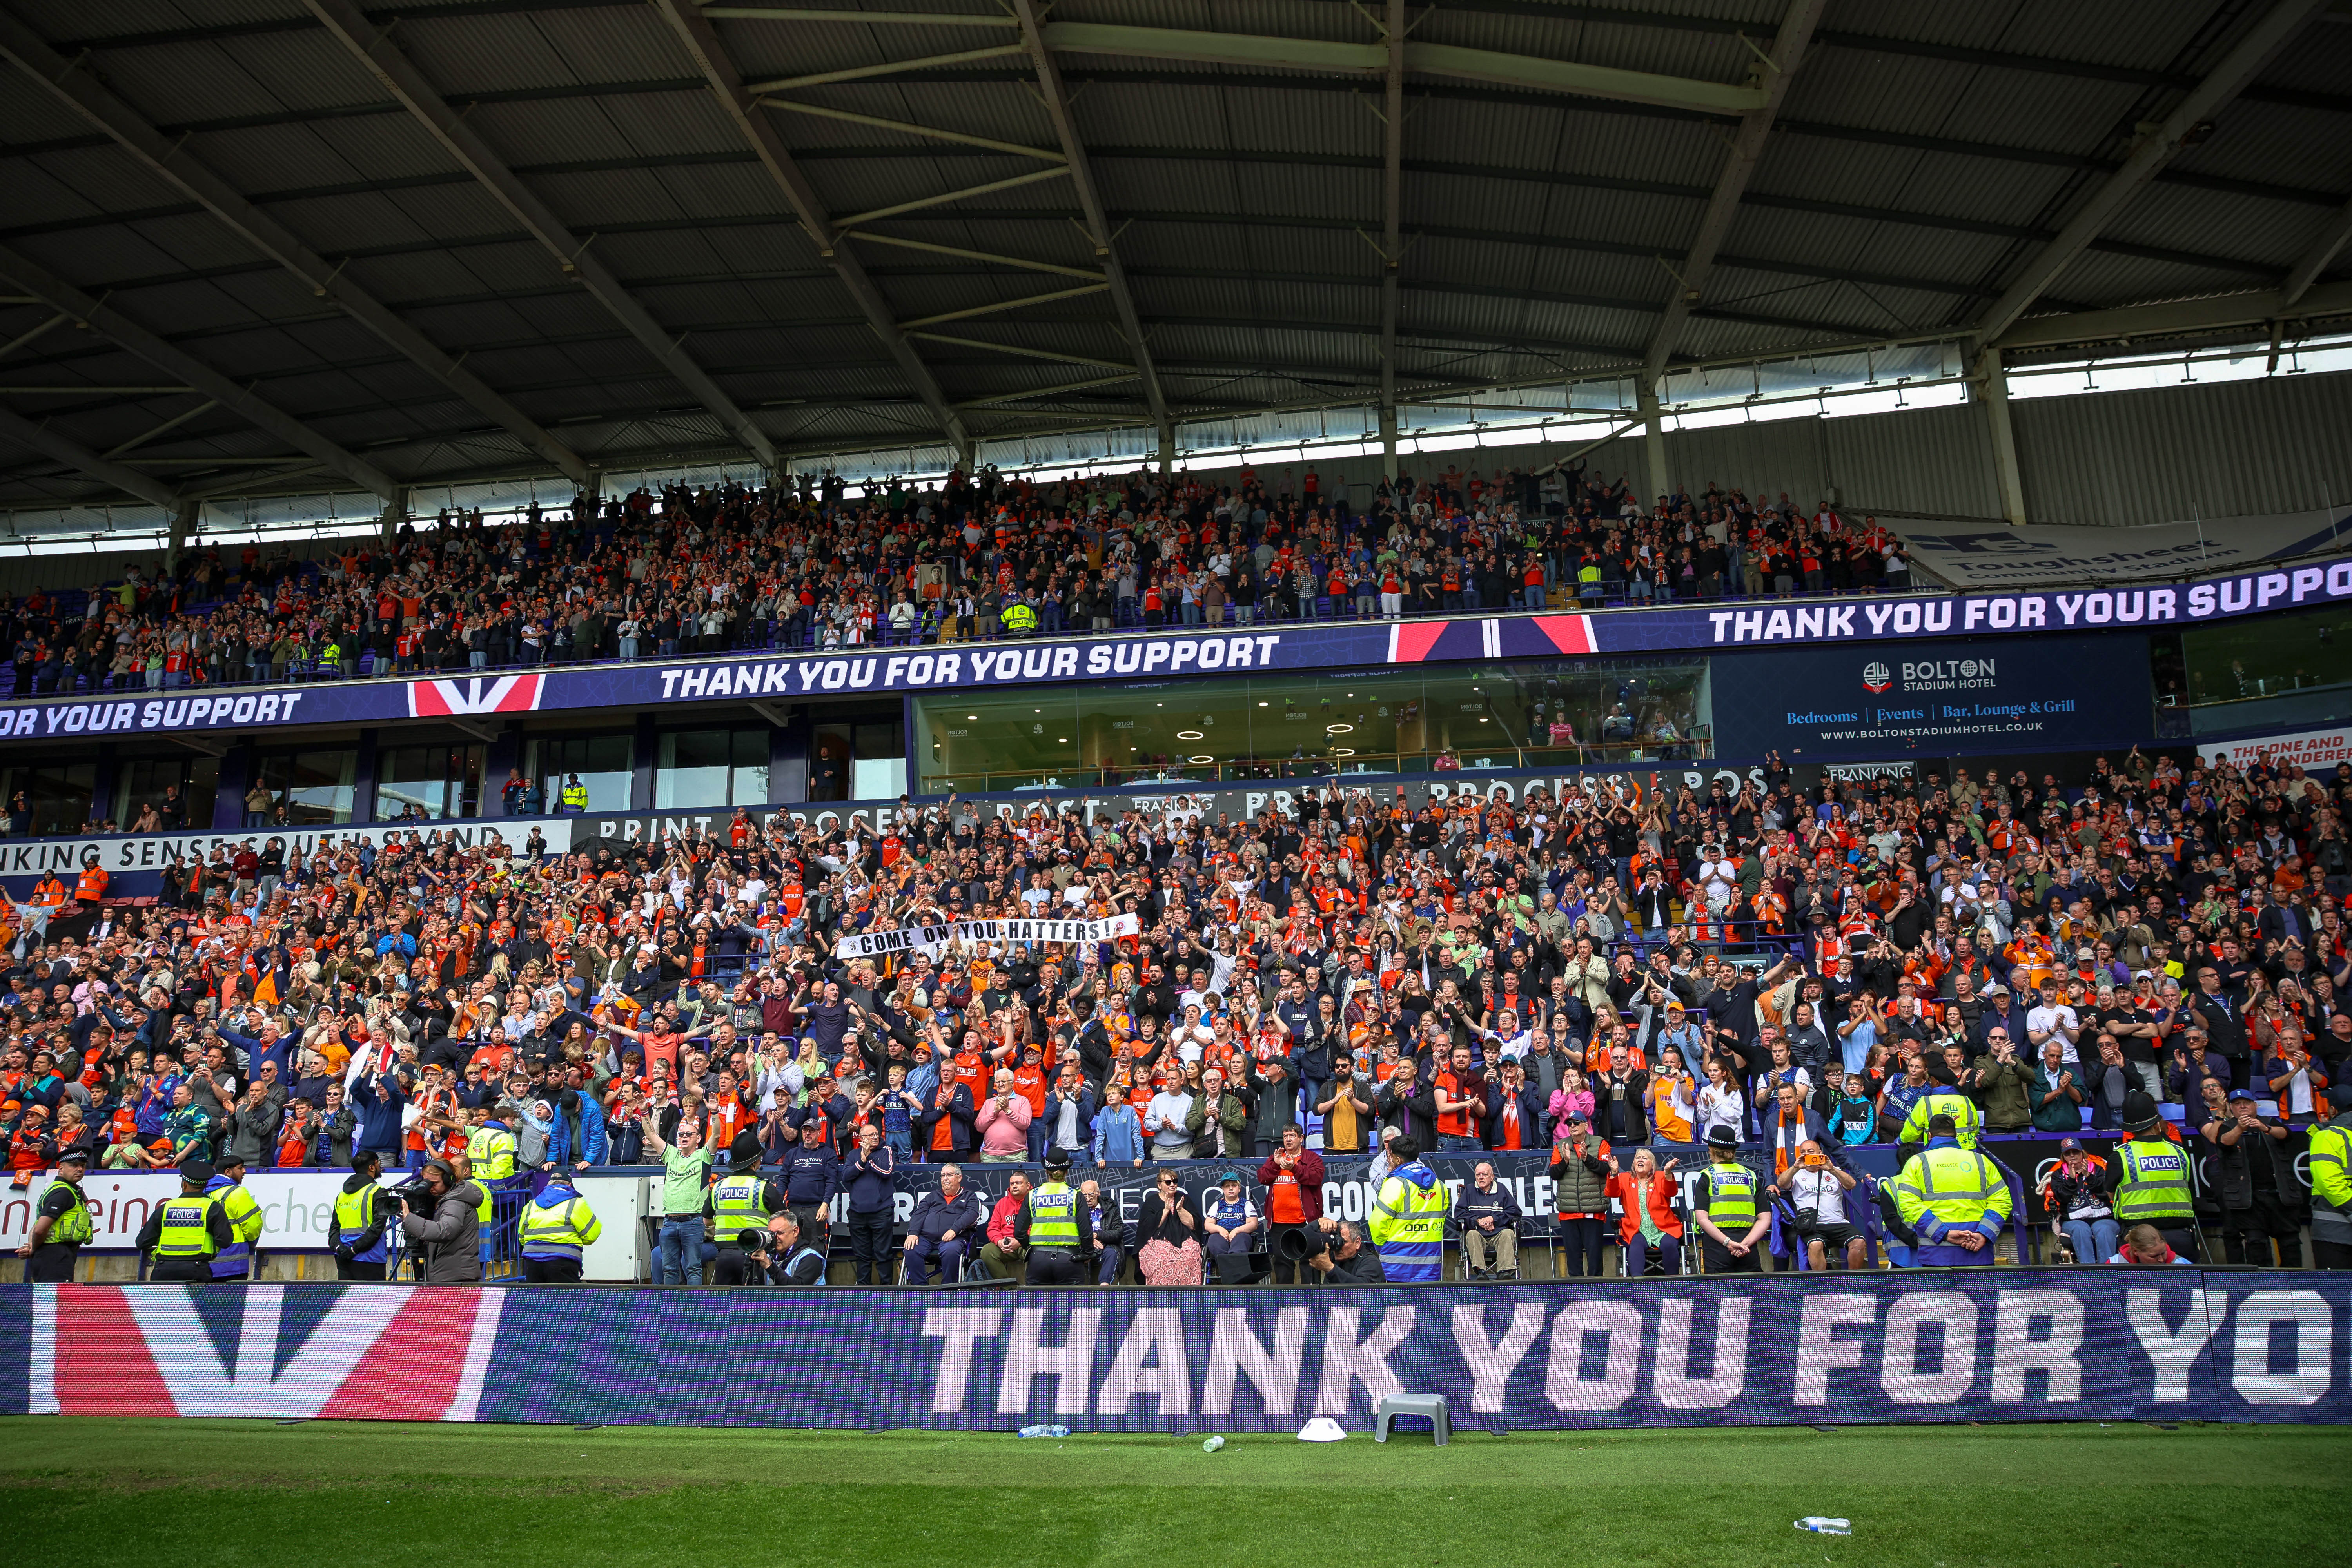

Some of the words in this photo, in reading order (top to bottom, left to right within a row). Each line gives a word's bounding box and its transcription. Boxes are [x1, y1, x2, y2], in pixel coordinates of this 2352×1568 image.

[1948, 538, 2222, 570] Toughsheet
[1967, 566, 2117, 579] Community
[2122, 548, 2241, 572] Stadium
[1709, 606, 1855, 642] THANK
[1866, 601, 1951, 634] YOU
[1965, 597, 2045, 629] FOR
[2056, 589, 2176, 625] YOUR
[2189, 563, 2352, 616] SUPPO
[661, 664, 790, 698] THANK
[799, 659, 877, 690] YOU
[884, 654, 961, 686] FOR
[971, 647, 1079, 681] YOUR
[1087, 636, 1280, 674] SUPPORT
[1903, 659, 1995, 680] BOLTON
[1904, 681, 1955, 691] STADIUM
[1959, 679, 1996, 688] HOTEL
[0, 709, 38, 736] OR
[47, 703, 136, 733] YOUR
[141, 693, 302, 728] SUPPORT
[1788, 712, 1858, 724] Bedrooms
[1877, 708, 1923, 720] Events
[1943, 706, 1971, 717] Bar,
[1975, 704, 2026, 718] Lounge
[2029, 702, 2041, 713] &
[2044, 700, 2074, 712] Grill
[1821, 722, 2042, 740] WWW.BOLTONSTADIUMHOTEL.CO.UK
[2234, 745, 2265, 758] THE
[2268, 740, 2303, 755] ONE
[2307, 736, 2344, 751] AND
[601, 817, 711, 841] PRINT
[860, 931, 913, 953] COME
[924, 926, 949, 943] ON
[960, 922, 996, 939] YOU
[1009, 921, 1109, 940] HATTERS!
[2140, 1158, 2179, 1169] POLICE
[720, 1189, 748, 1198] POLICE
[1036, 1196, 1067, 1206] POLICE
[923, 1306, 1417, 1414] THANK
[1452, 1298, 1751, 1412] YOU
[1793, 1290, 2085, 1406] FOR
[2126, 1289, 2336, 1405] YO
